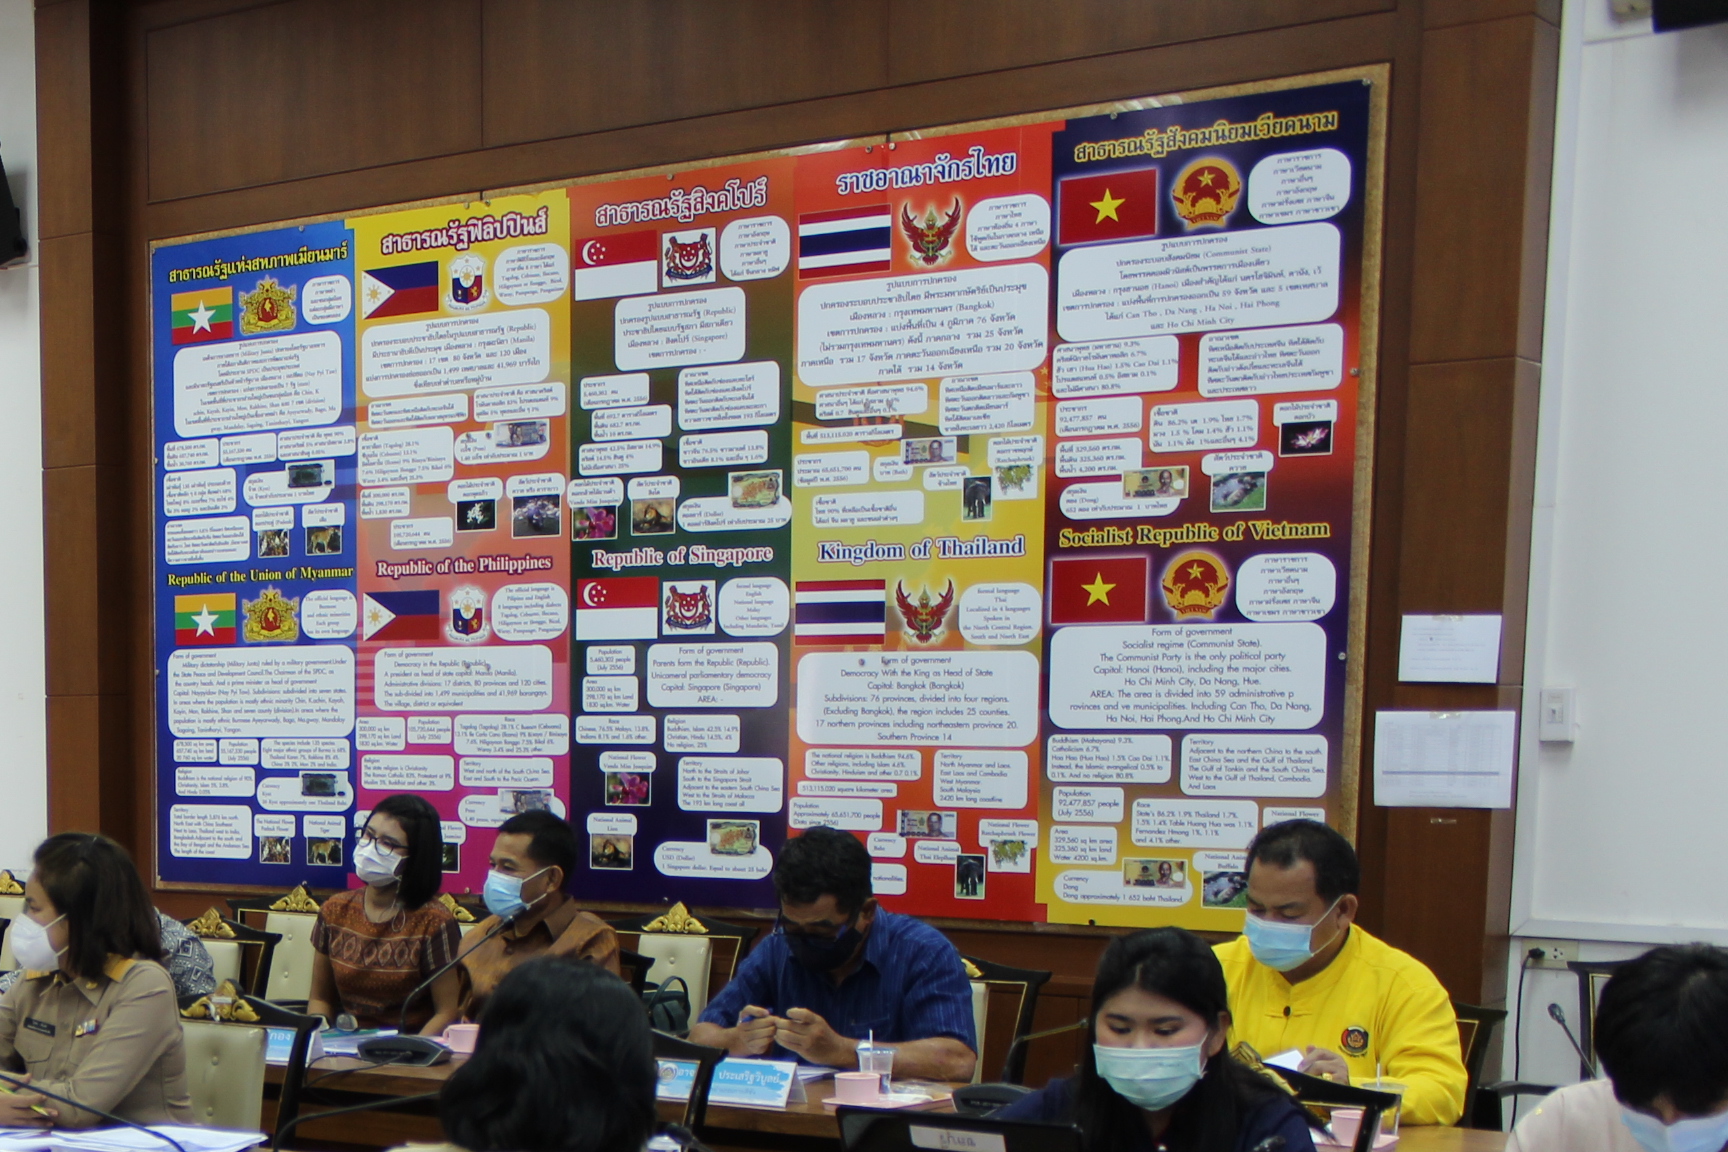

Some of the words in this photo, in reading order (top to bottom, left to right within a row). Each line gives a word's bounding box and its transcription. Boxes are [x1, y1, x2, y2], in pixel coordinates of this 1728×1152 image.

[1076, 112, 1336, 161] สาธารณรัฐสังคมนิยมเวียดนาม
[837, 147, 1016, 194] ราชอาณาจักรไทย
[597, 178, 766, 226] สาธารณรัฐสิงคโปร์
[382, 208, 548, 253] สาธารณรัฐฟิลิปปินส์
[170, 241, 348, 282] สาธารณรัฐแห่งสหภาพเมียนมาร์
[1061, 528, 1132, 546] Socialist
[1138, 524, 1216, 547] Republic
[1224, 523, 1243, 541] of
[1250, 521, 1329, 539] Vietnam
[818, 541, 904, 564] Kingdom
[911, 538, 931, 558] of
[936, 537, 1024, 558] Thailand
[592, 548, 663, 569] Republic
[668, 546, 684, 563] of
[690, 546, 772, 566] Singapore
[378, 560, 432, 578] Republic
[437, 560, 450, 573] of
[454, 559, 474, 572] the
[479, 555, 551, 573] Philippines
[168, 573, 212, 587] Republic
[216, 571, 226, 582] of
[230, 570, 246, 581] the
[250, 569, 281, 581] Union
[286, 568, 296, 579] of
[300, 566, 353, 580] Myanmar
[1152, 628, 1172, 636] Form
[1175, 627, 1183, 635] of
[1186, 628, 1232, 637] government
[1123, 640, 1154, 649] Socialist
[1157, 640, 1184, 650] regime
[1187, 639, 1234, 648] (Communist
[697, 646, 704, 654] of
[706, 647, 743, 656] government
[1100, 653, 1113, 661] The
[1117, 653, 1159, 661] Communist
[1162, 653, 1181, 662] Party
[1194, 652, 1206, 660] the
[1209, 651, 1226, 662] only
[1230, 650, 1261, 662] political
[1264, 652, 1286, 662] party
[678, 658, 692, 666] form
[695, 658, 704, 666] the
[707, 658, 733, 667] Republic
[901, 655, 908, 663] of
[911, 657, 951, 665] government
[841, 669, 879, 678] Democracy
[881, 668, 898, 676] With
[901, 668, 911, 676] the
[914, 669, 930, 678] King
[944, 668, 962, 676] Head
[965, 668, 972, 676] of
[1126, 665, 1149, 673] Hanoi
[1188, 664, 1224, 674] including
[1227, 663, 1239, 672] the
[1242, 664, 1266, 674] major
[651, 671, 687, 679] Unicameral
[689, 670, 734, 680] parliamentary
[736, 670, 771, 679] democracy
[1139, 677, 1152, 685] Chi
[1155, 676, 1175, 685] Minh
[1200, 677, 1211, 685] Da
[688, 683, 721, 692] Singapore
[723, 683, 761, 692] (Singapore)
[897, 681, 926, 691] Bangkok
[929, 681, 964, 691] (Bangkok)
[871, 694, 880, 702] 76
[920, 694, 945, 702] divided
[964, 694, 978, 702] four
[1118, 689, 1131, 698] The
[1164, 688, 1194, 697] divided
[1215, 689, 1226, 697] 59
[1229, 688, 1285, 697] administrative
[823, 706, 858, 716] (Excluding
[897, 706, 908, 715] the
[911, 708, 932, 717] region
[936, 707, 964, 715] includes
[967, 707, 976, 715] 25
[1070, 702, 1100, 710] rovinces
[1103, 701, 1118, 710] and
[1191, 701, 1227, 712] Including
[1230, 701, 1246, 710] Can
[1271, 701, 1282, 709] Da
[1106, 714, 1117, 722] Ha
[1140, 714, 1154, 722] Hai
[1204, 714, 1215, 722] Ho
[1218, 713, 1232, 722] Chi
[1235, 714, 1255, 722] Minh
[1259, 714, 1275, 724] City
[827, 719, 855, 727] northern
[858, 720, 890, 729] provinces
[893, 719, 924, 730] including
[927, 720, 970, 728] northeastern
[973, 721, 1003, 730] province
[878, 732, 908, 740] Southern
[1059, 789, 1091, 798] Population
[1058, 799, 1096, 807] 92,477,857
[1098, 800, 1119, 808] people
[1058, 808, 1072, 817] (July
